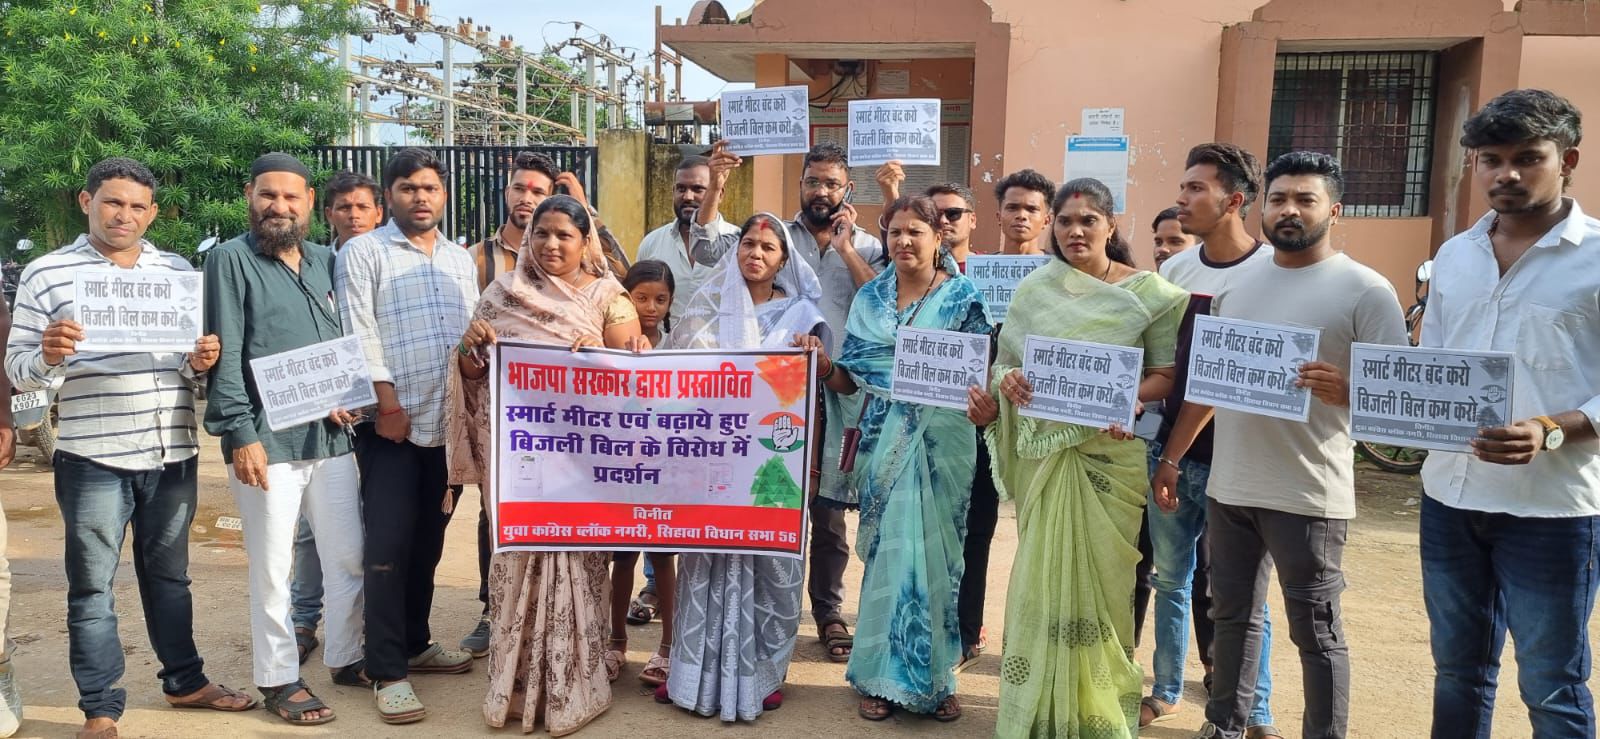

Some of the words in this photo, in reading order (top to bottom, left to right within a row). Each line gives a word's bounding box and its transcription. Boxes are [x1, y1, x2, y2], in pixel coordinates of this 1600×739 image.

[728, 96, 743, 113] स्मार्ट
[745, 96, 760, 112] मीटर
[774, 93, 786, 111] करो
[856, 106, 872, 123] स्मार्ट
[874, 106, 890, 123] मीटर
[904, 106, 918, 122] करो
[726, 119, 747, 136] बिजली
[750, 119, 763, 135] बिल
[765, 121, 777, 134] कम
[779, 116, 791, 134] करो
[853, 129, 876, 147] बिजली
[878, 129, 892, 145] बिल
[894, 132, 907, 144] कम
[908, 128, 921, 145] करो
[974, 261, 990, 278] स्मार्ट
[992, 262, 1009, 278] मीटर
[1011, 261, 1021, 278] बंद
[84, 276, 109, 298] स्मार्ट
[111, 278, 135, 298] मीटर
[137, 277, 152, 298] बंद
[154, 278, 172, 299] करो
[997, 286, 1012, 302] बिल
[81, 305, 115, 326] बिजली
[119, 306, 139, 326] बिल
[141, 311, 158, 326] कम
[161, 306, 178, 327] करो
[903, 334, 919, 354] स्मार्ट
[920, 337, 936, 356] मीटर
[938, 338, 948, 357] बंद
[950, 340, 964, 359] करो
[1202, 326, 1223, 348] स्मार्ट
[1224, 328, 1247, 352] मीटर
[1249, 330, 1264, 354] बंद
[1265, 334, 1284, 358] करो
[264, 361, 286, 383] स्मार्ट
[286, 359, 308, 377] मीटर
[307, 352, 321, 370] बंद
[321, 349, 338, 367] करो
[898, 359, 920, 380] बिजली
[921, 362, 937, 382] बिल
[938, 368, 951, 384] कम
[952, 367, 967, 386] करो
[1034, 345, 1055, 366] स्मार्ट
[1056, 347, 1077, 369] मीटर
[1079, 350, 1092, 372] बंद
[1094, 353, 1112, 374] करो
[1194, 354, 1225, 380] बिजली
[1226, 360, 1246, 384] बिल
[1248, 368, 1265, 386] कम
[1267, 366, 1287, 391] करो
[1362, 354, 1390, 379] स्मार्ट
[1394, 357, 1422, 382] मीटर
[1425, 358, 1443, 384] बंद
[1446, 360, 1470, 386] करो
[267, 385, 298, 408] बिजली
[298, 382, 318, 400] बिल
[318, 378, 333, 394] कम
[334, 371, 351, 388] करो
[508, 361, 567, 393] भाजपा
[572, 367, 631, 397] सरकार
[636, 371, 672, 399] द्वारा
[678, 362, 754, 399] प्रस्तावित
[1058, 376, 1077, 398] बिल
[1079, 383, 1095, 400] कम
[1096, 382, 1113, 403] करो
[1357, 387, 1397, 415] बिजली
[1400, 391, 1425, 418] बिल
[1429, 400, 1450, 420] कम
[1454, 396, 1478, 422] करो
[506, 402, 556, 423] स्मार्ट
[562, 405, 612, 428] मीटर
[619, 408, 652, 429] एवं
[656, 408, 713, 434] बढ़ाये
[719, 413, 750, 436] हुए
[510, 430, 584, 453] बिजली
[590, 434, 635, 457] बिल
[640, 436, 661, 457] के
[667, 436, 726, 457] विरोध
[732, 435, 751, 456] में
[593, 463, 661, 484] प्रदर्शन
[633, 507, 672, 520] विनीत
[503, 525, 528, 540] युवा
[576, 524, 612, 536] ब्लॉक
[615, 524, 652, 539] नगरी,
[657, 524, 700, 538] सिहावा
[705, 525, 744, 540] विधान
[748, 530, 775, 542] सभा
[779, 532, 796, 543] 56
